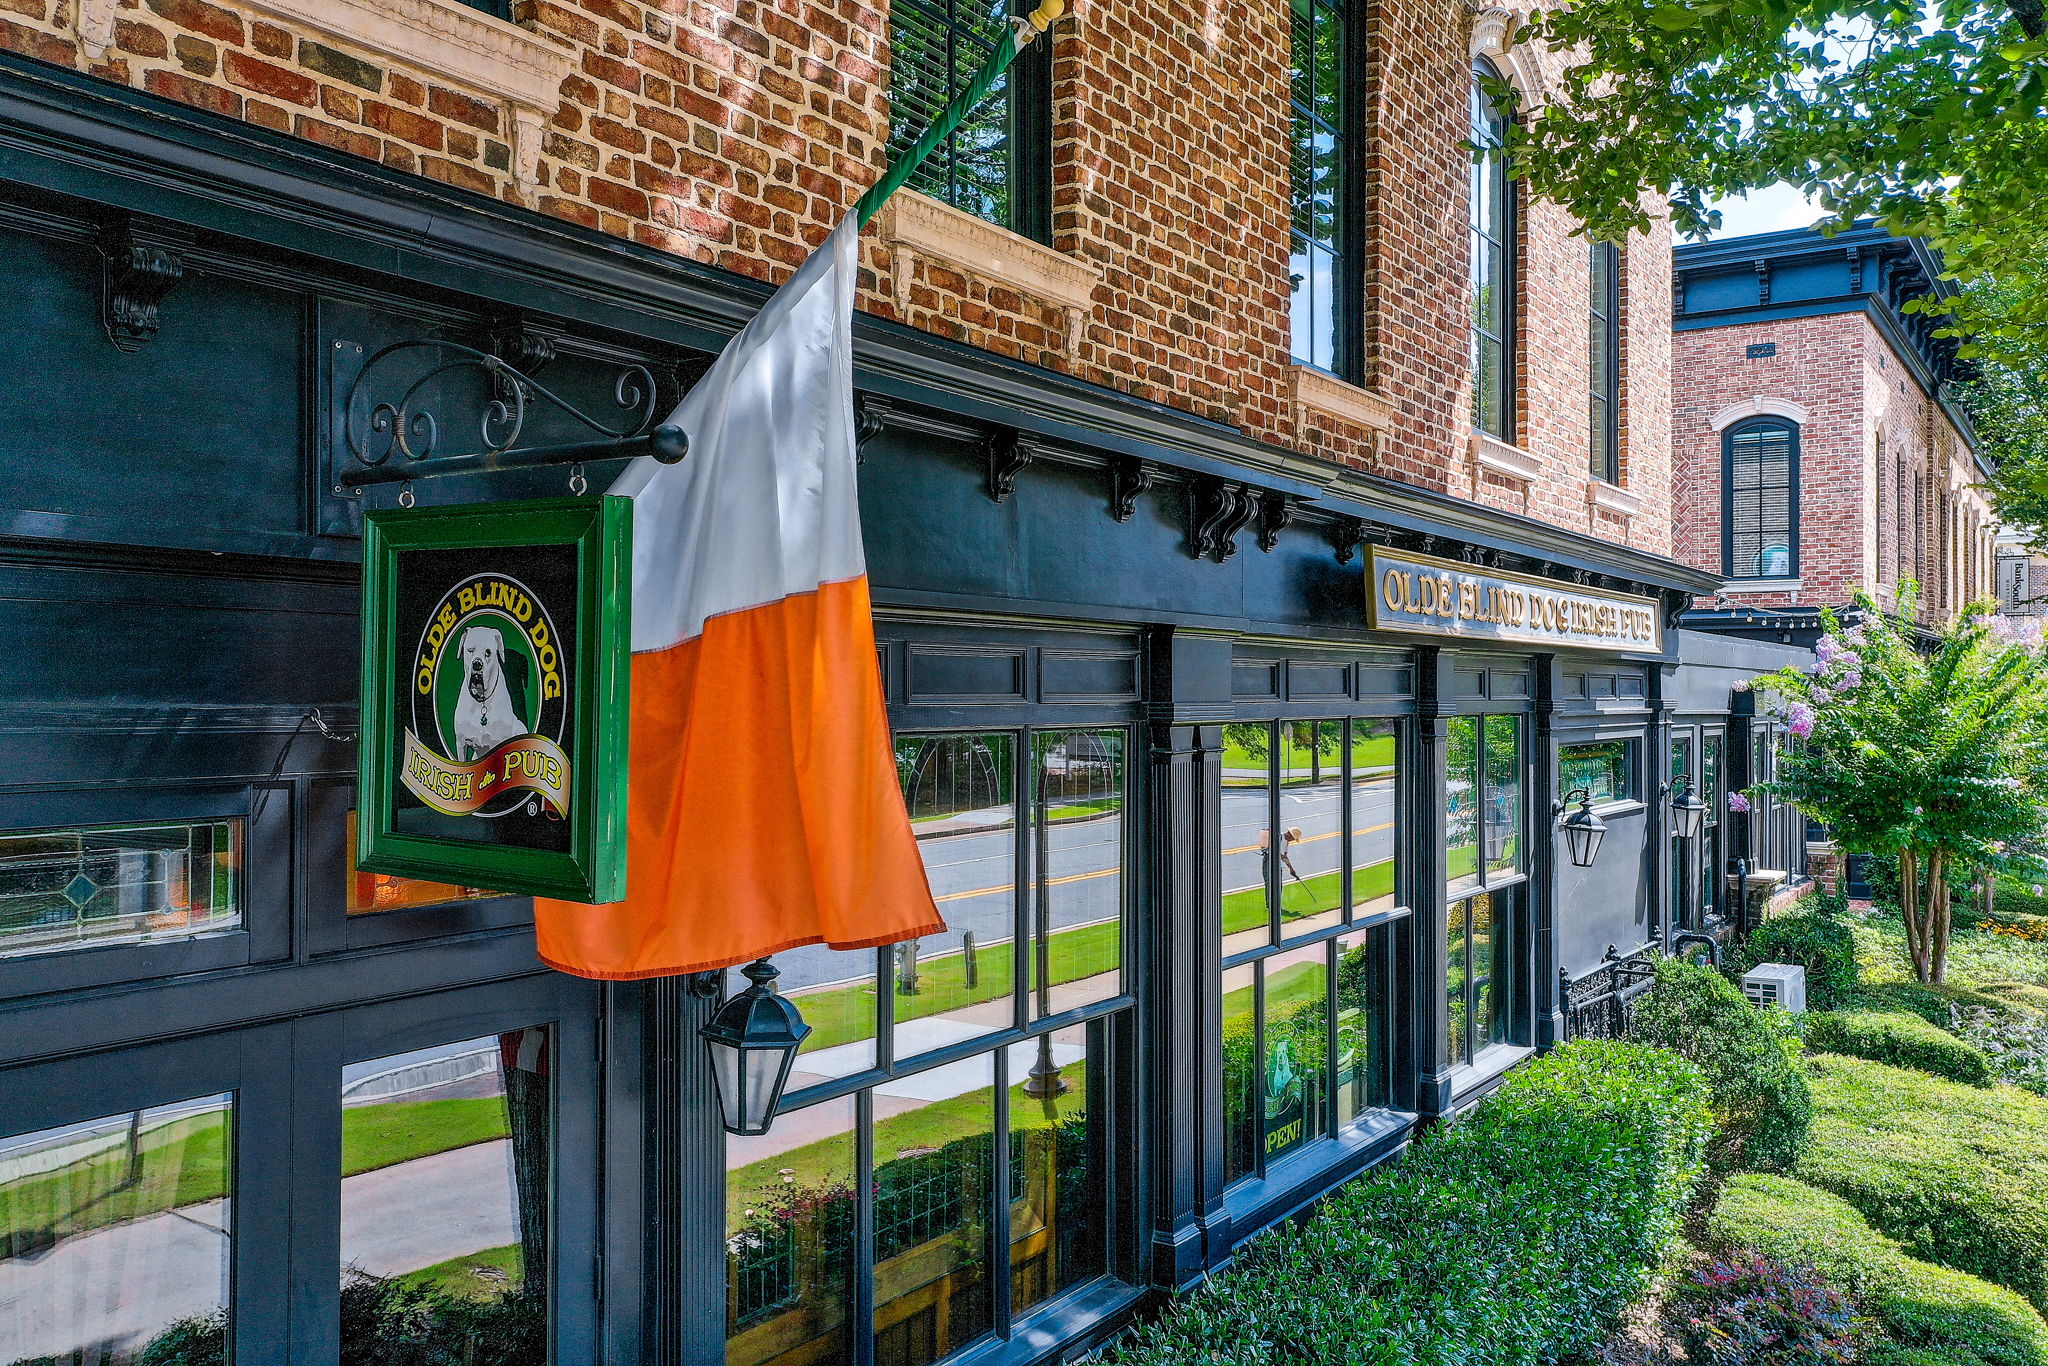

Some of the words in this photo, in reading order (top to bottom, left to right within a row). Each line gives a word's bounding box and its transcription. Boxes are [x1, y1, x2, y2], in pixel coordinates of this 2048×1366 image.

[1383, 568, 1453, 617] OLDE
[1457, 581, 1526, 627] BLIND
[1528, 592, 1569, 632] DOG
[1570, 601, 1618, 637] IRISH
[1620, 609, 1652, 641] PUB
[2012, 563, 2024, 609] BankSouth
[418, 603, 458, 695] OLDE
[459, 582, 533, 621] BLIND
[530, 618, 561, 701] DOG
[408, 748, 475, 801] IRISH
[502, 750, 562, 790] PUB
[1265, 1118, 1302, 1153] PEN!
